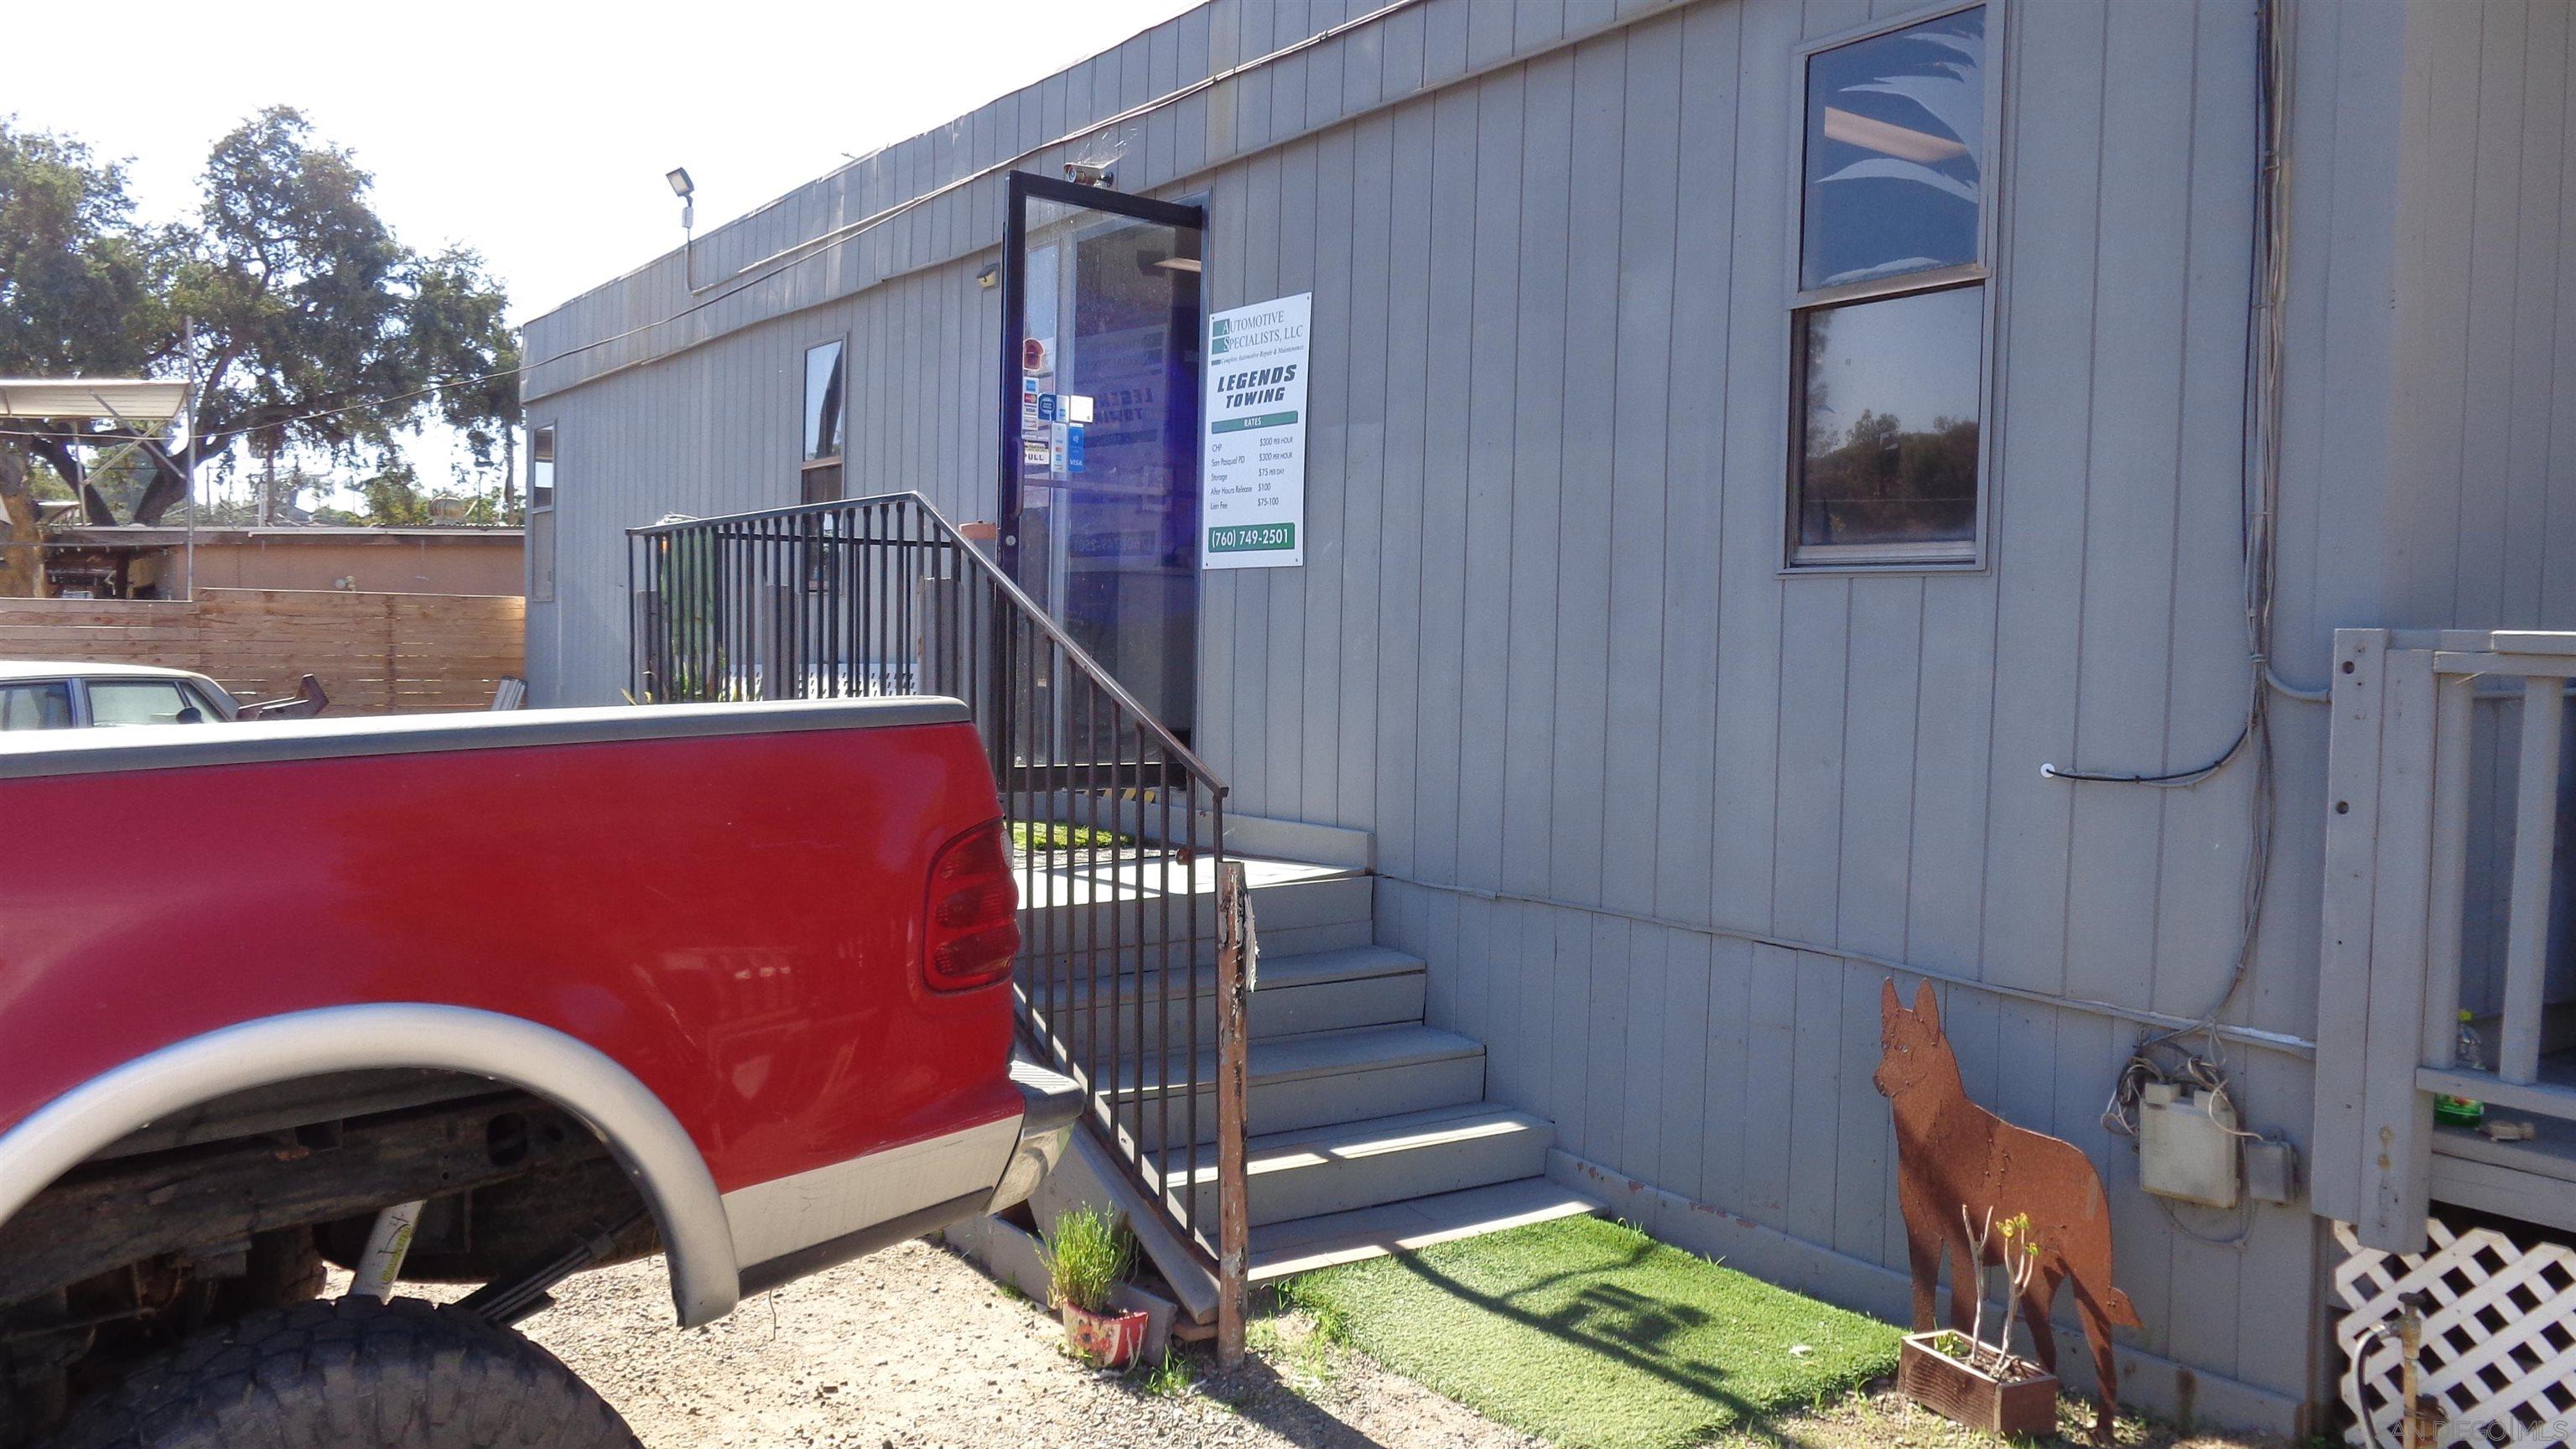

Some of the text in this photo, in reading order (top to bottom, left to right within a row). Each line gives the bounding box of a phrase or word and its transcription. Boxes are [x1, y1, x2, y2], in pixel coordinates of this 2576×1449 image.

[1222, 310, 1284, 335] AUTOMOTIVE
[1223, 325, 1303, 351] SPECIALISTS, LLC
[1259, 350, 1273, 358] Repair
[1218, 364, 1297, 393] LEGENDS
[1226, 387, 1285, 408] TOWING
[1244, 417, 1262, 428] RATES
[1212, 444, 1222, 452] CHP
[1259, 437, 1273, 447] $300
[1280, 436, 1294, 444] HOUR
[1212, 459, 1220, 467] San
[1221, 456, 1238, 467] Pasqual
[1238, 455, 1245, 464] PD
[1259, 452, 1272, 462] $300
[1211, 473, 1228, 482] Storage
[1259, 468, 1269, 477] $75
[1210, 482, 1271, 496] After Hours Release $100
[1219, 501, 1228, 509] Fee
[1258, 496, 1280, 507] $75-100
[1212, 528, 1288, 548] (760) 749-2501
